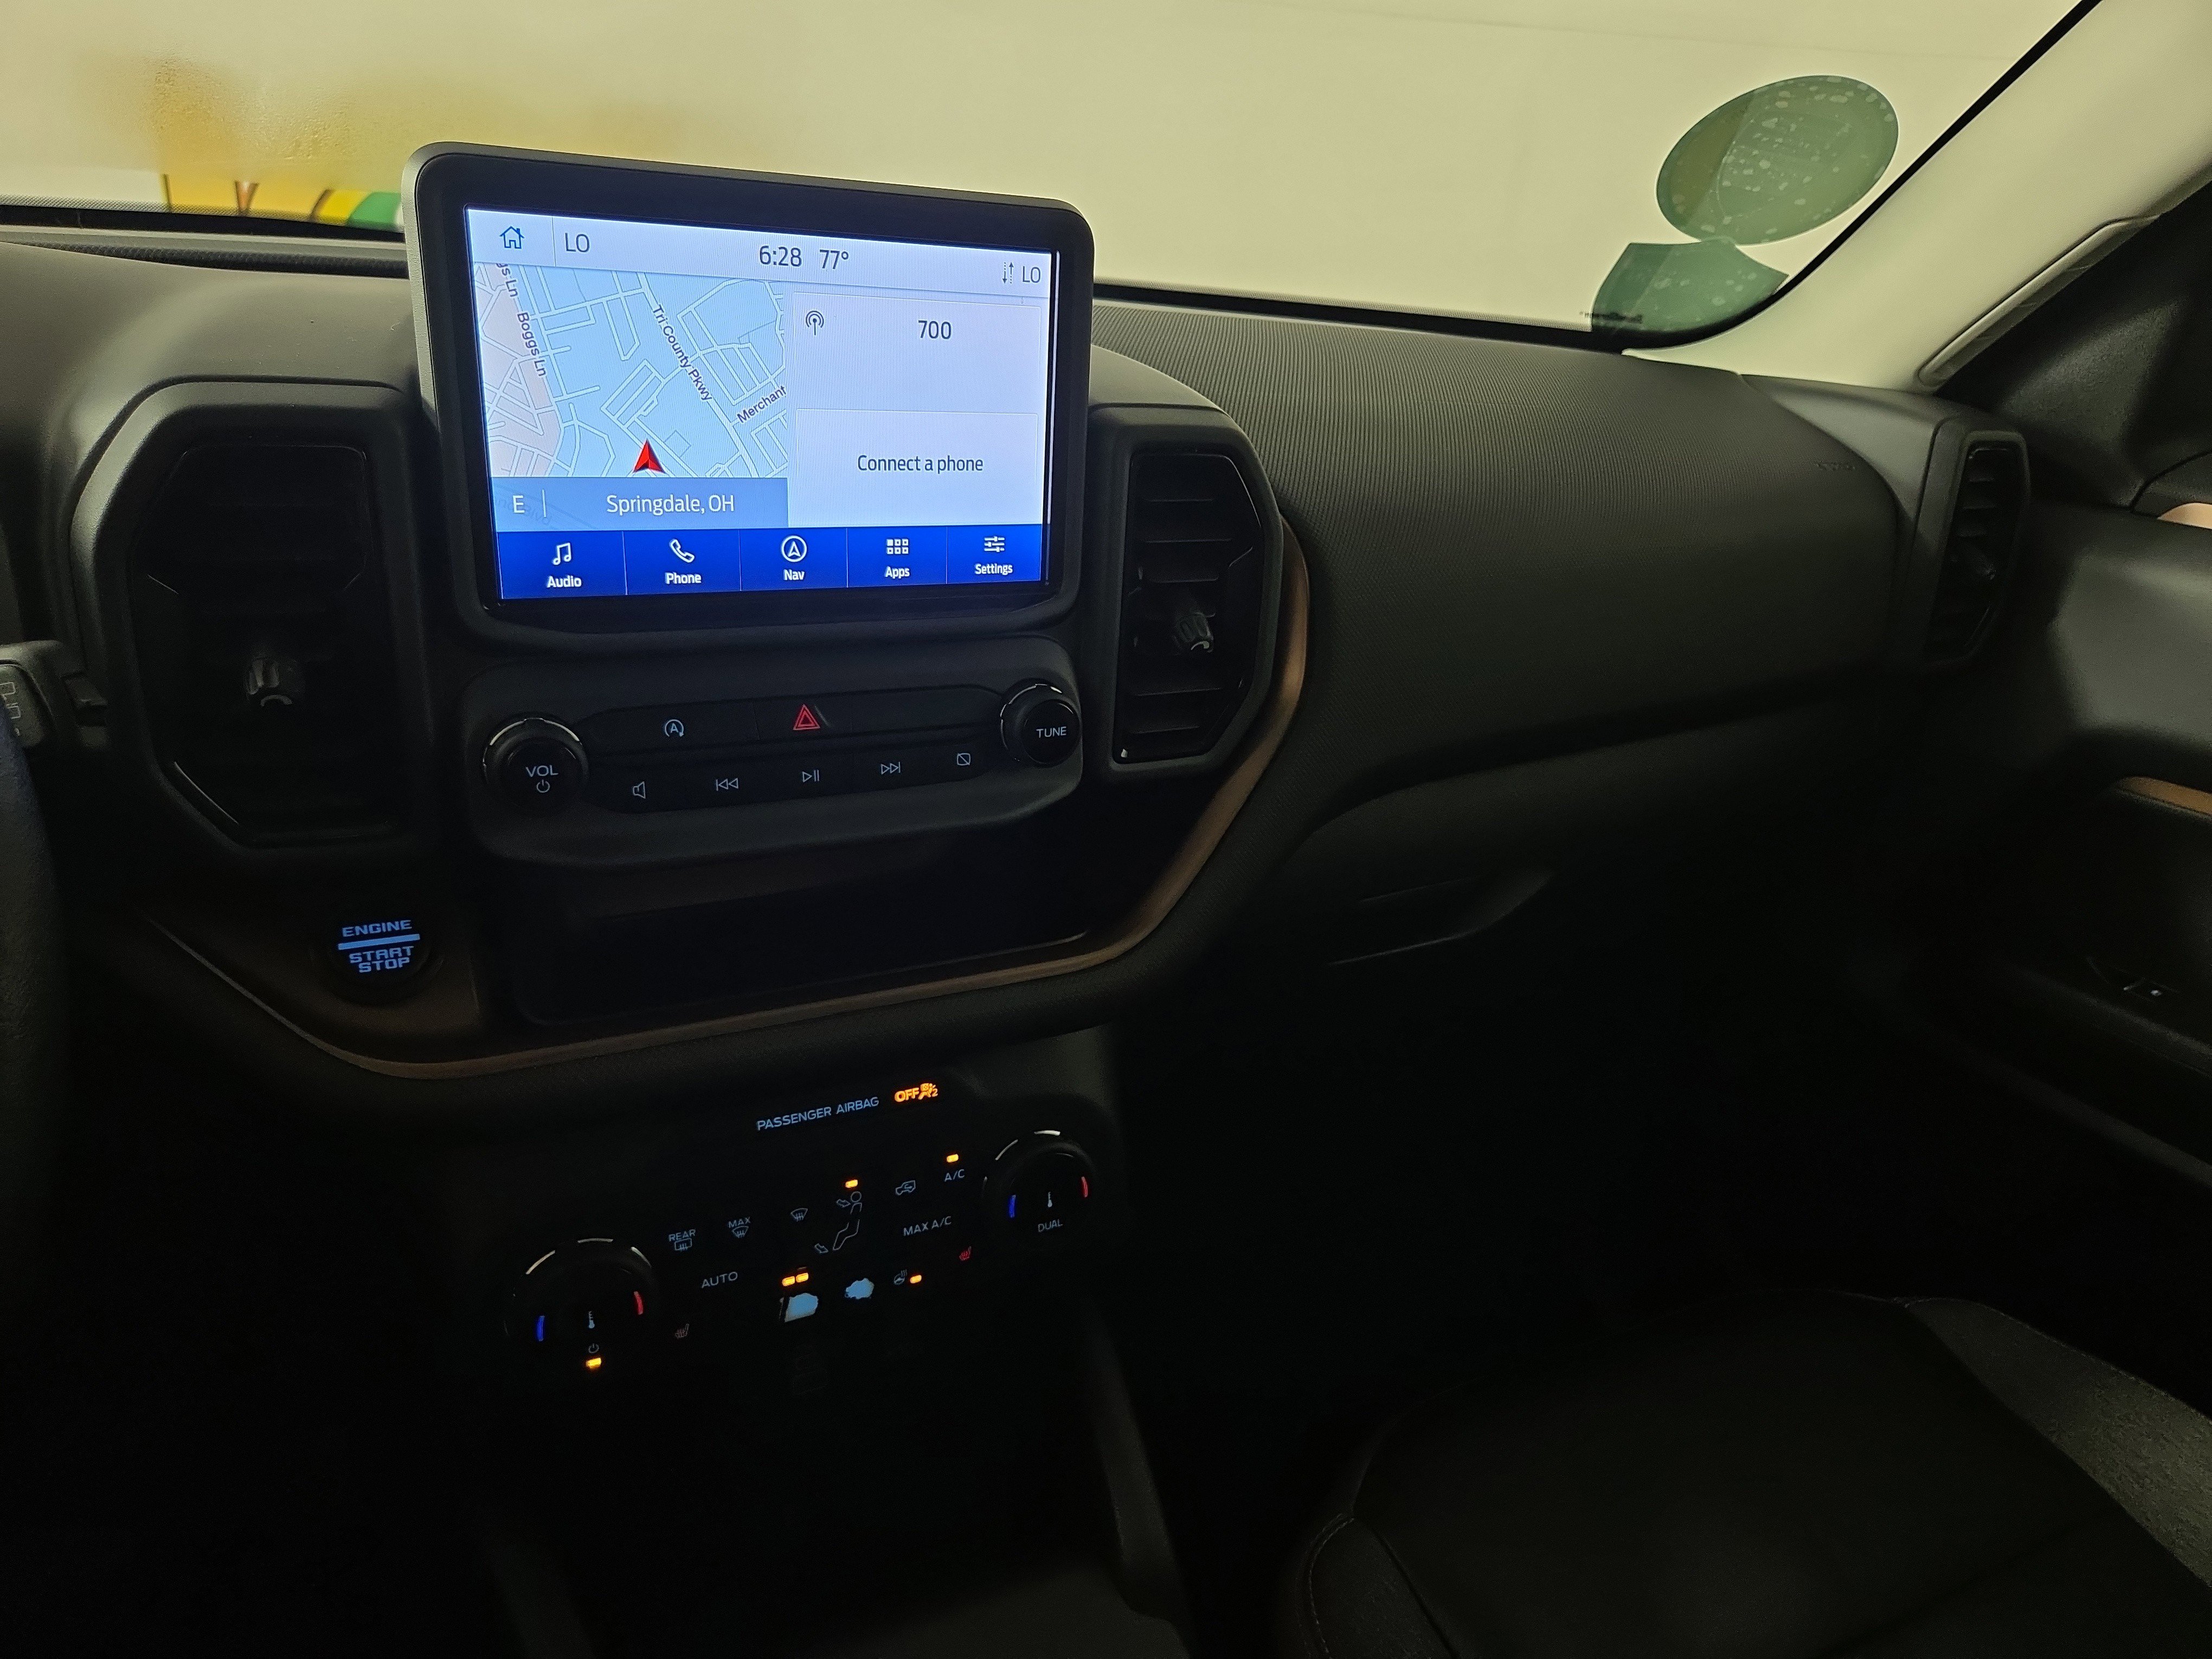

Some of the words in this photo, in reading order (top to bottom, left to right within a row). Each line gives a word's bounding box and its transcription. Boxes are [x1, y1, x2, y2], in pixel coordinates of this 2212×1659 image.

[565, 233, 590, 253] LO
[760, 245, 802, 267] 6:28
[819, 249, 849, 269] 77°
[1022, 266, 1041, 284] LO
[505, 279, 518, 298] Ln
[918, 320, 951, 339] 700
[517, 312, 540, 356] Boggs
[534, 359, 546, 377] Ln
[653, 304, 668, 324] Tri
[663, 325, 691, 368] County
[688, 369, 712, 401] Pkwy
[737, 385, 787, 423] Merchant
[858, 455, 921, 471] Connect
[924, 459, 934, 471] a
[937, 455, 983, 474] phone
[513, 495, 525, 513] E
[607, 494, 705, 516] Springdale,
[709, 494, 734, 512] OH
[666, 572, 702, 584] Phone
[784, 569, 805, 581] Nav
[885, 566, 910, 580] Apps
[975, 563, 1013, 576] Settings
[547, 575, 582, 588] Audio
[670, 723, 679, 733] A
[1036, 726, 1066, 738] TUNE
[525, 764, 558, 777] VOL
[342, 919, 413, 937] ENGINE
[349, 946, 414, 964] START
[358, 957, 410, 973] STOP
[757, 1107, 832, 1130] PASSENGER
[836, 1096, 879, 1114] AIRBAG
[894, 1087, 919, 1103] OFF
[944, 1169, 964, 1182] A/C
[728, 1217, 751, 1229] MAX
[903, 1222, 929, 1236] MAX
[931, 1216, 951, 1229] A/C
[1038, 1219, 1063, 1232] DUAL
[668, 1229, 696, 1242] REAR
[702, 1271, 738, 1288] AUTO
